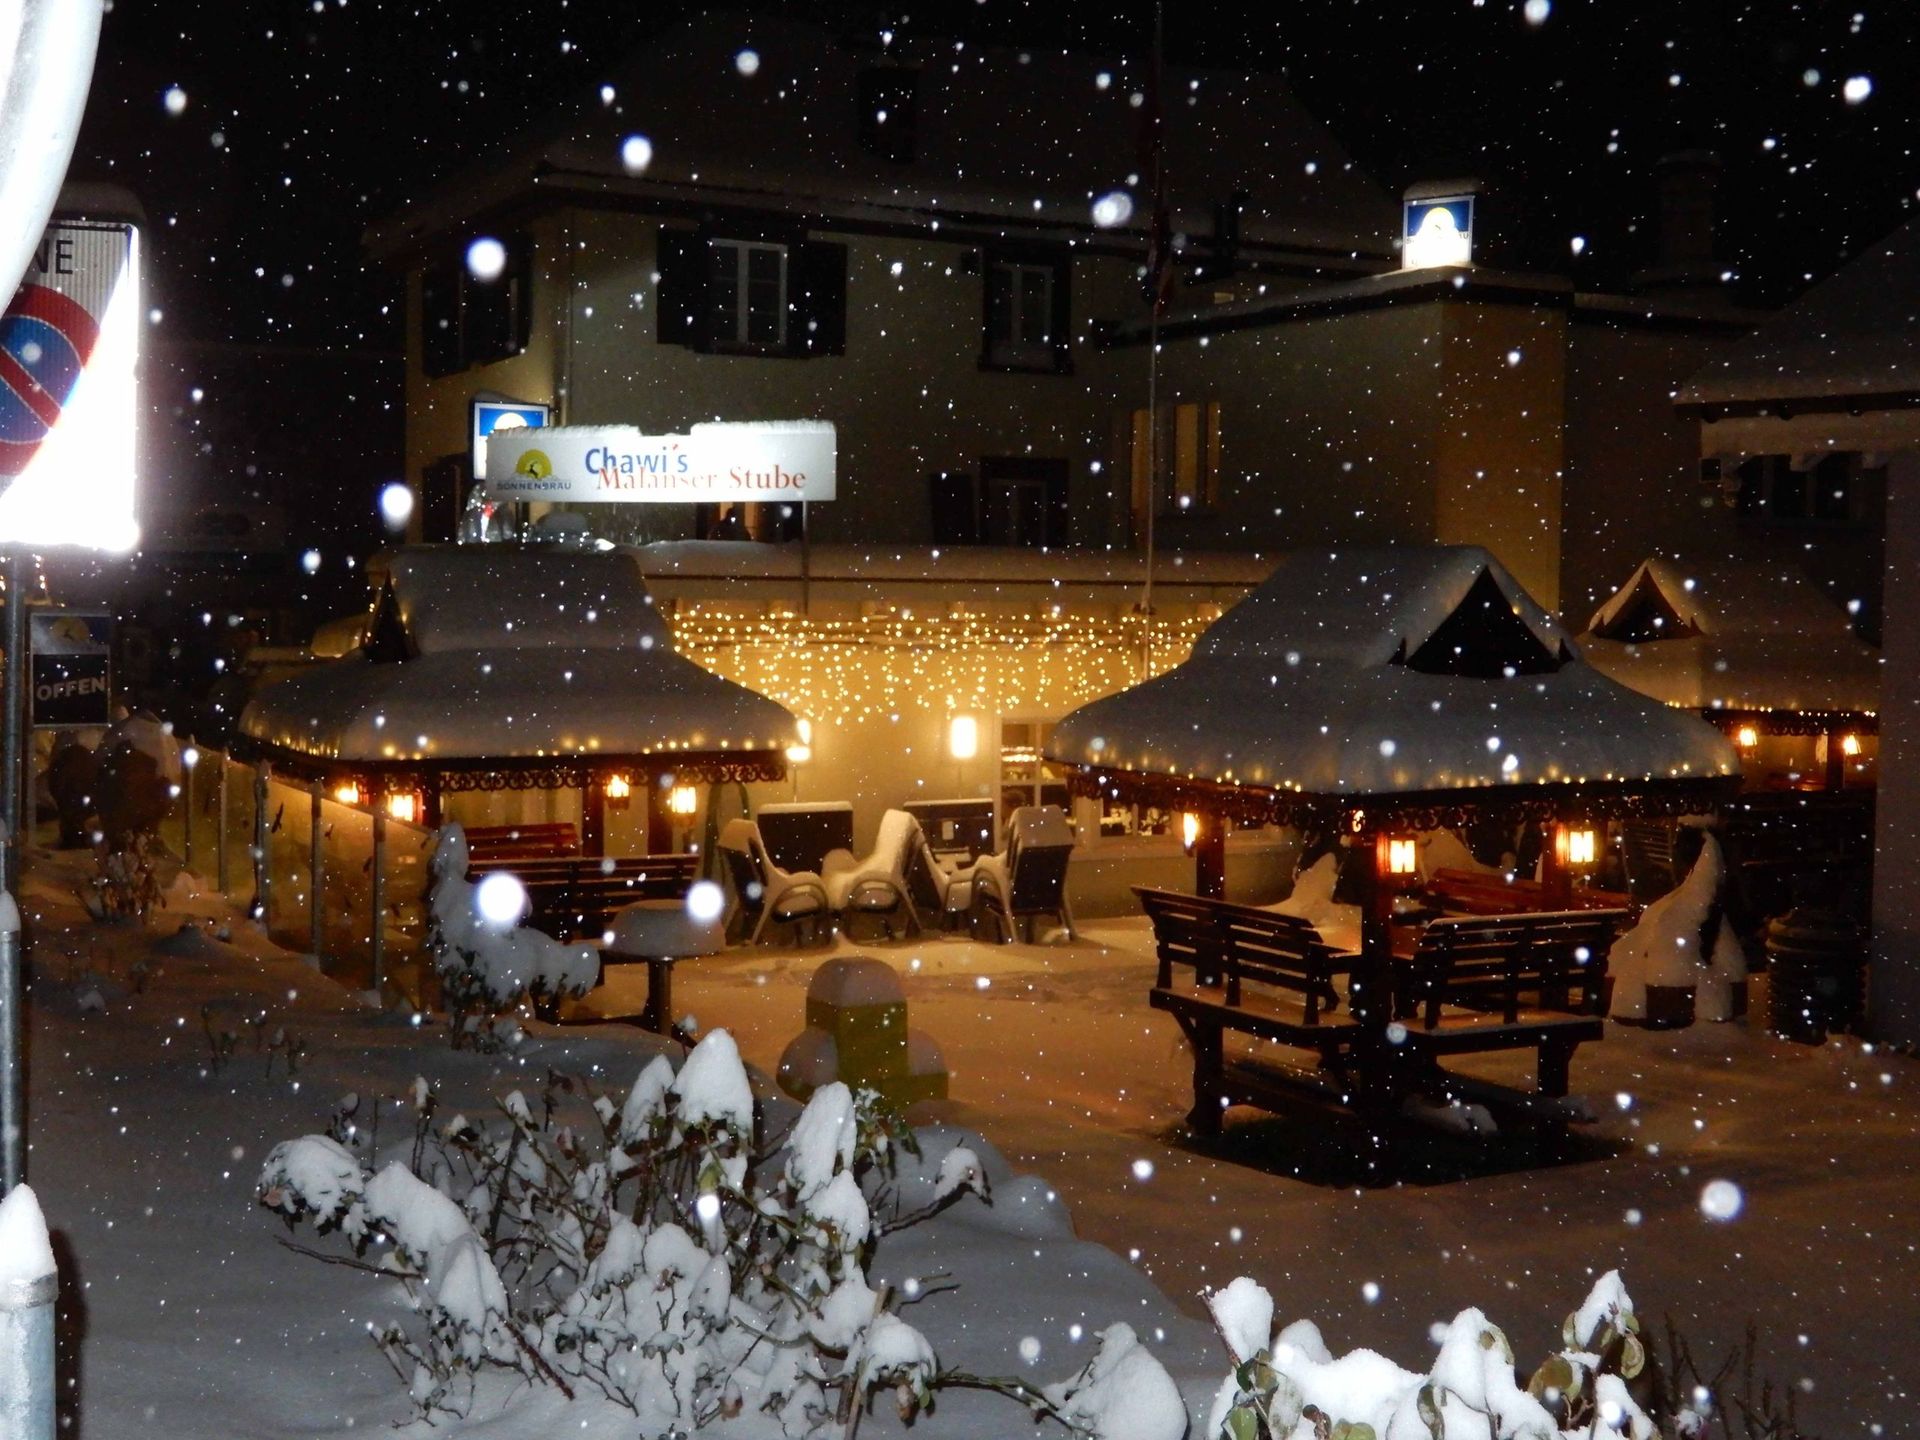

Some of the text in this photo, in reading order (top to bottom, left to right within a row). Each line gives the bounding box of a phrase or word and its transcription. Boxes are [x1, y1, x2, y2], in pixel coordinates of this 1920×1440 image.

[33, 238, 73, 274] NE
[729, 464, 807, 489] Stube
[36, 677, 106, 701] OFFEN
